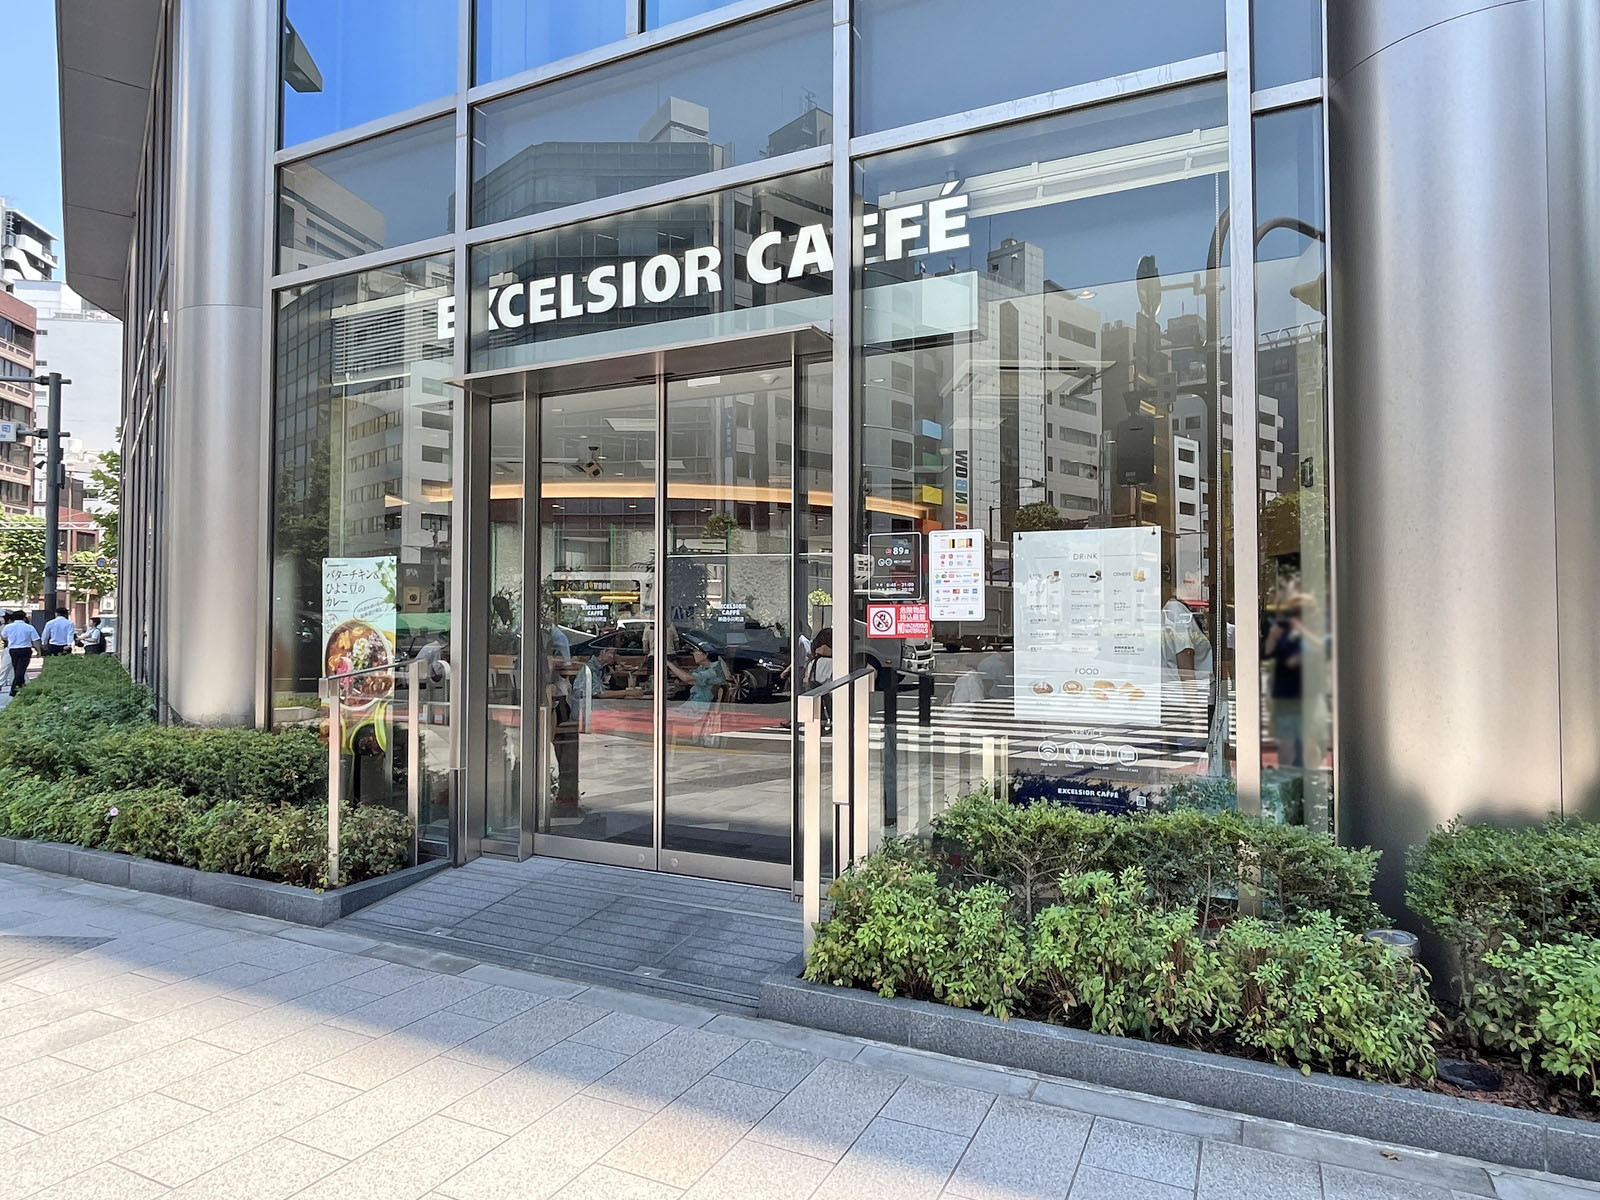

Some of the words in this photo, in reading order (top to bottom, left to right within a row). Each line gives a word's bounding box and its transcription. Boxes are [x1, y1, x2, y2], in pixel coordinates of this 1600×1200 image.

[326, 582, 366, 595] ひよこ豆の
[326, 597, 349, 607] カレー
[1058, 787, 1095, 797] EXCELSIOR
[1096, 789, 1119, 799] CAFFÉ
